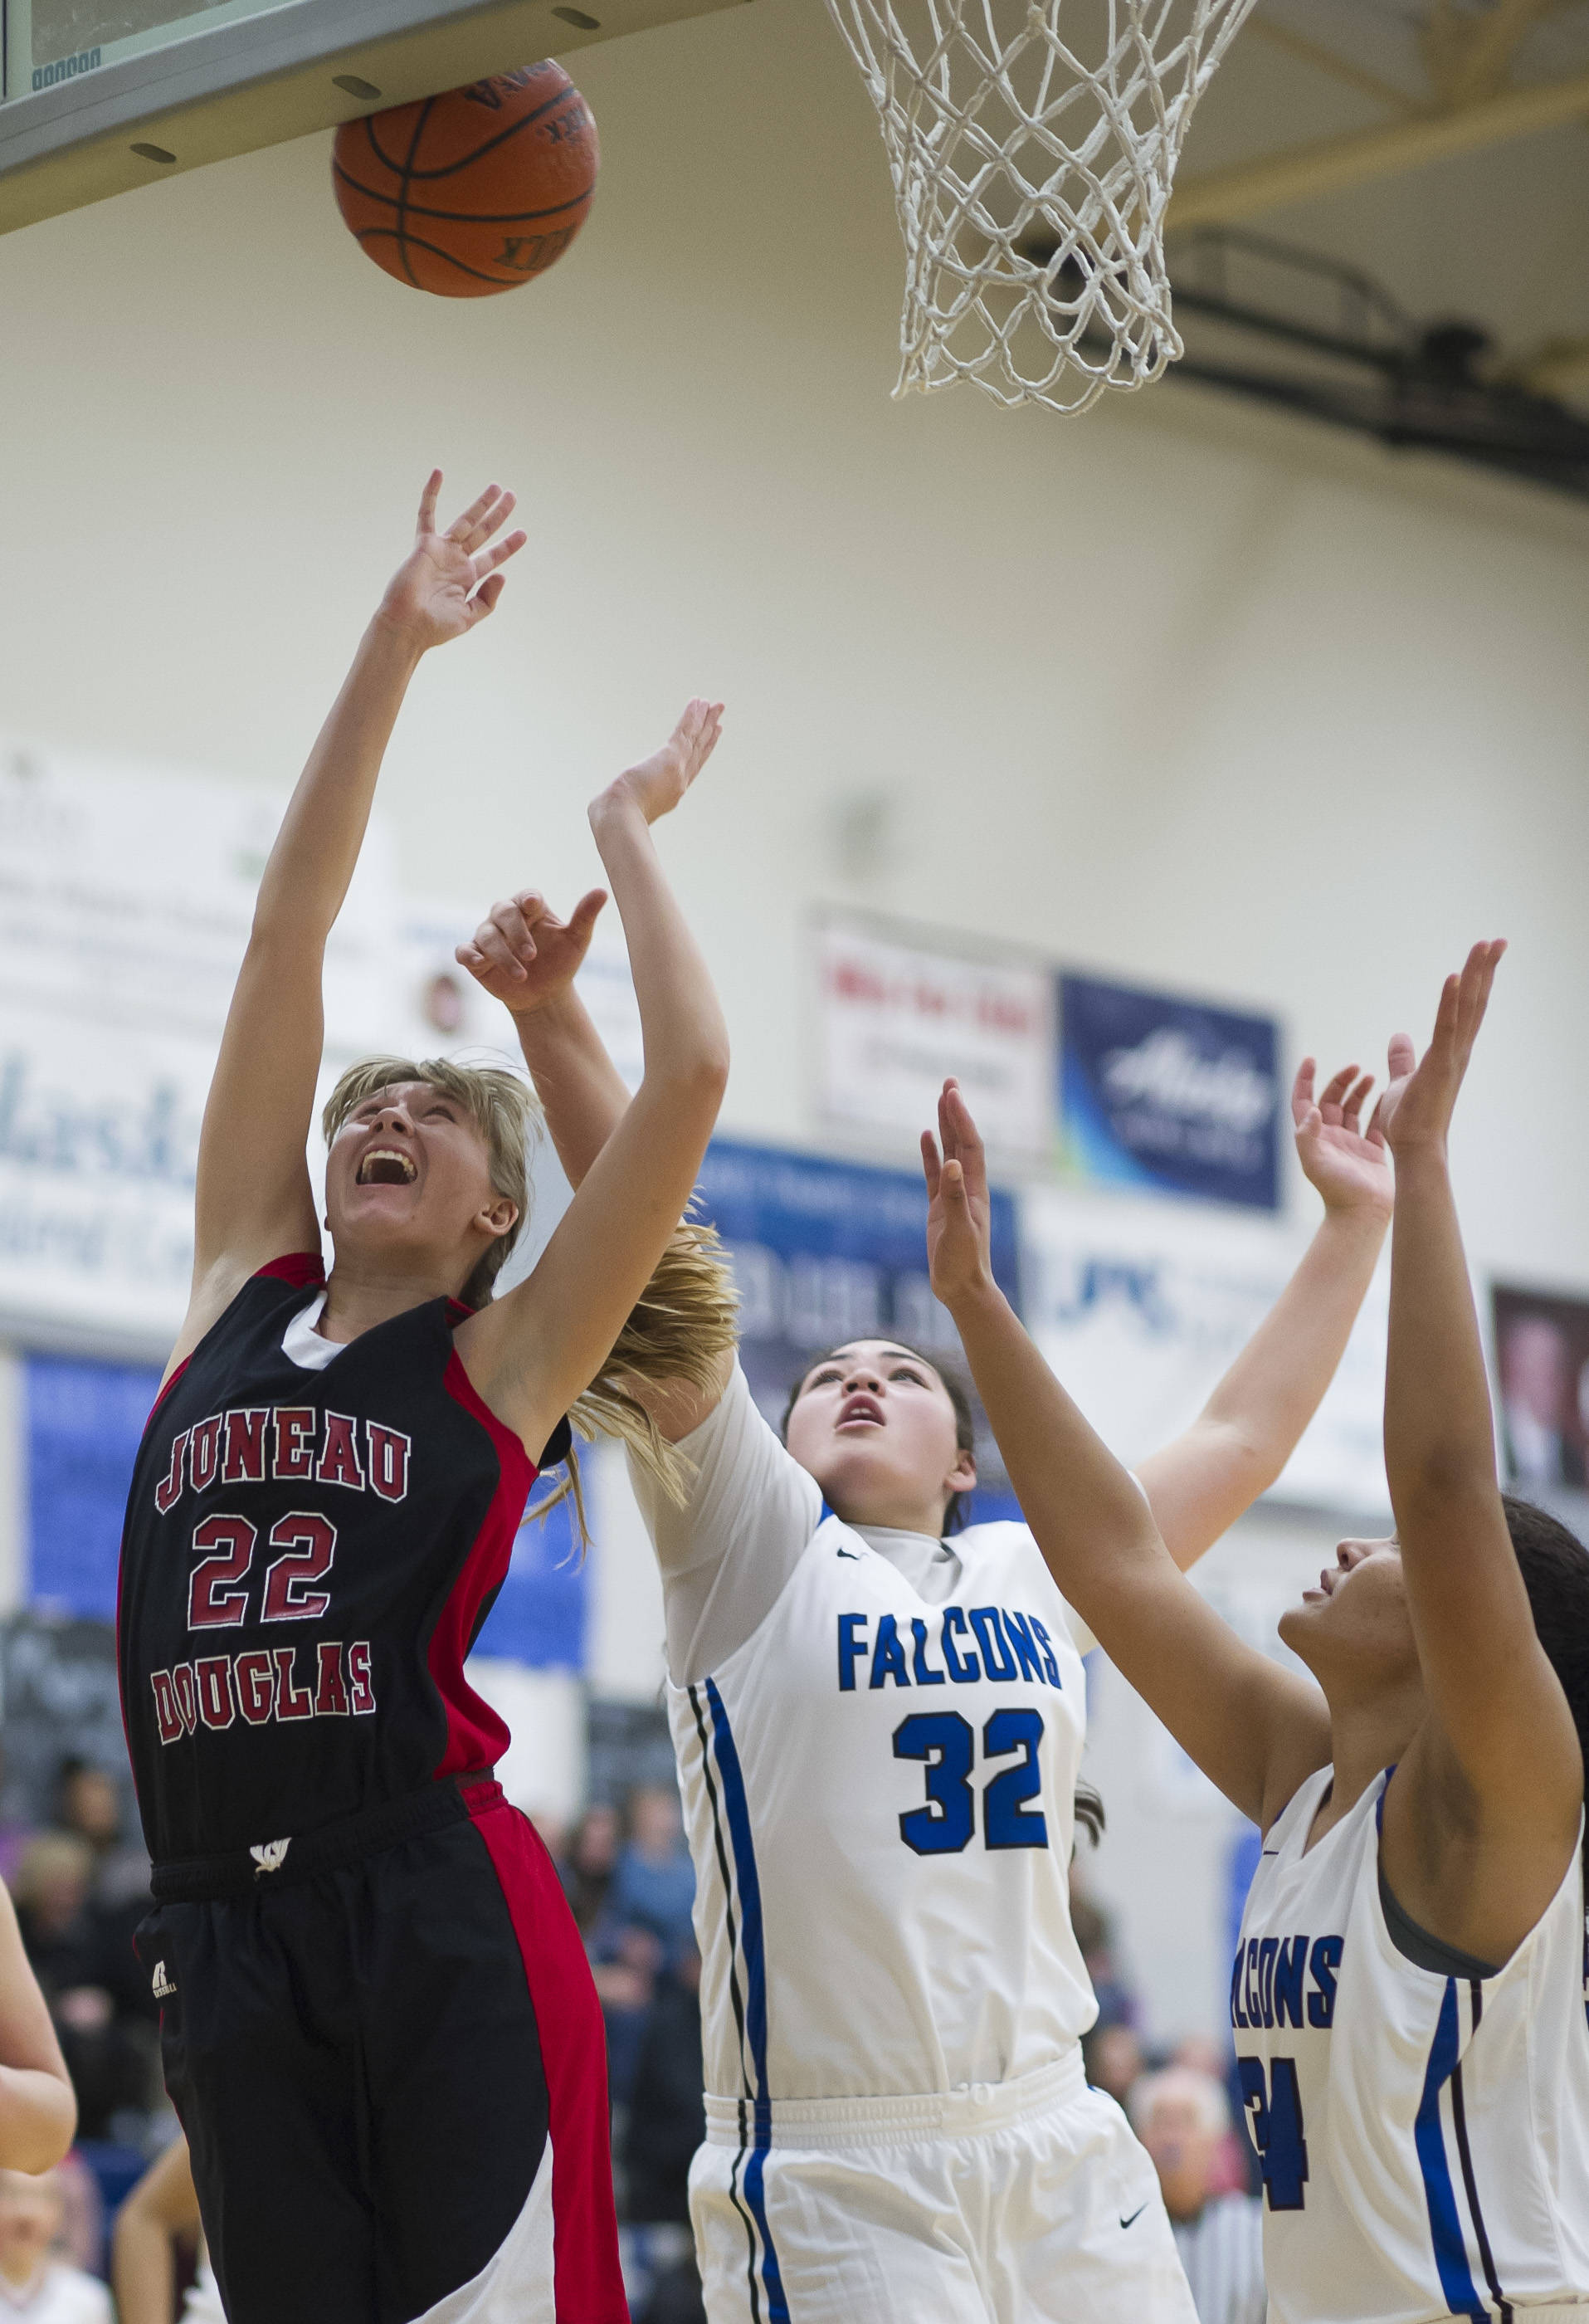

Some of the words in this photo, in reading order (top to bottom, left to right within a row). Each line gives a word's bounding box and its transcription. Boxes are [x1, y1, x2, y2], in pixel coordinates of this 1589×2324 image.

[154, 1407, 412, 1516] JUNEAU
[187, 1511, 338, 1632] 22
[150, 1641, 377, 1746] DOUGLAS
[837, 1605, 1063, 1692] FALCONS
[892, 1708, 1049, 1856] 32
